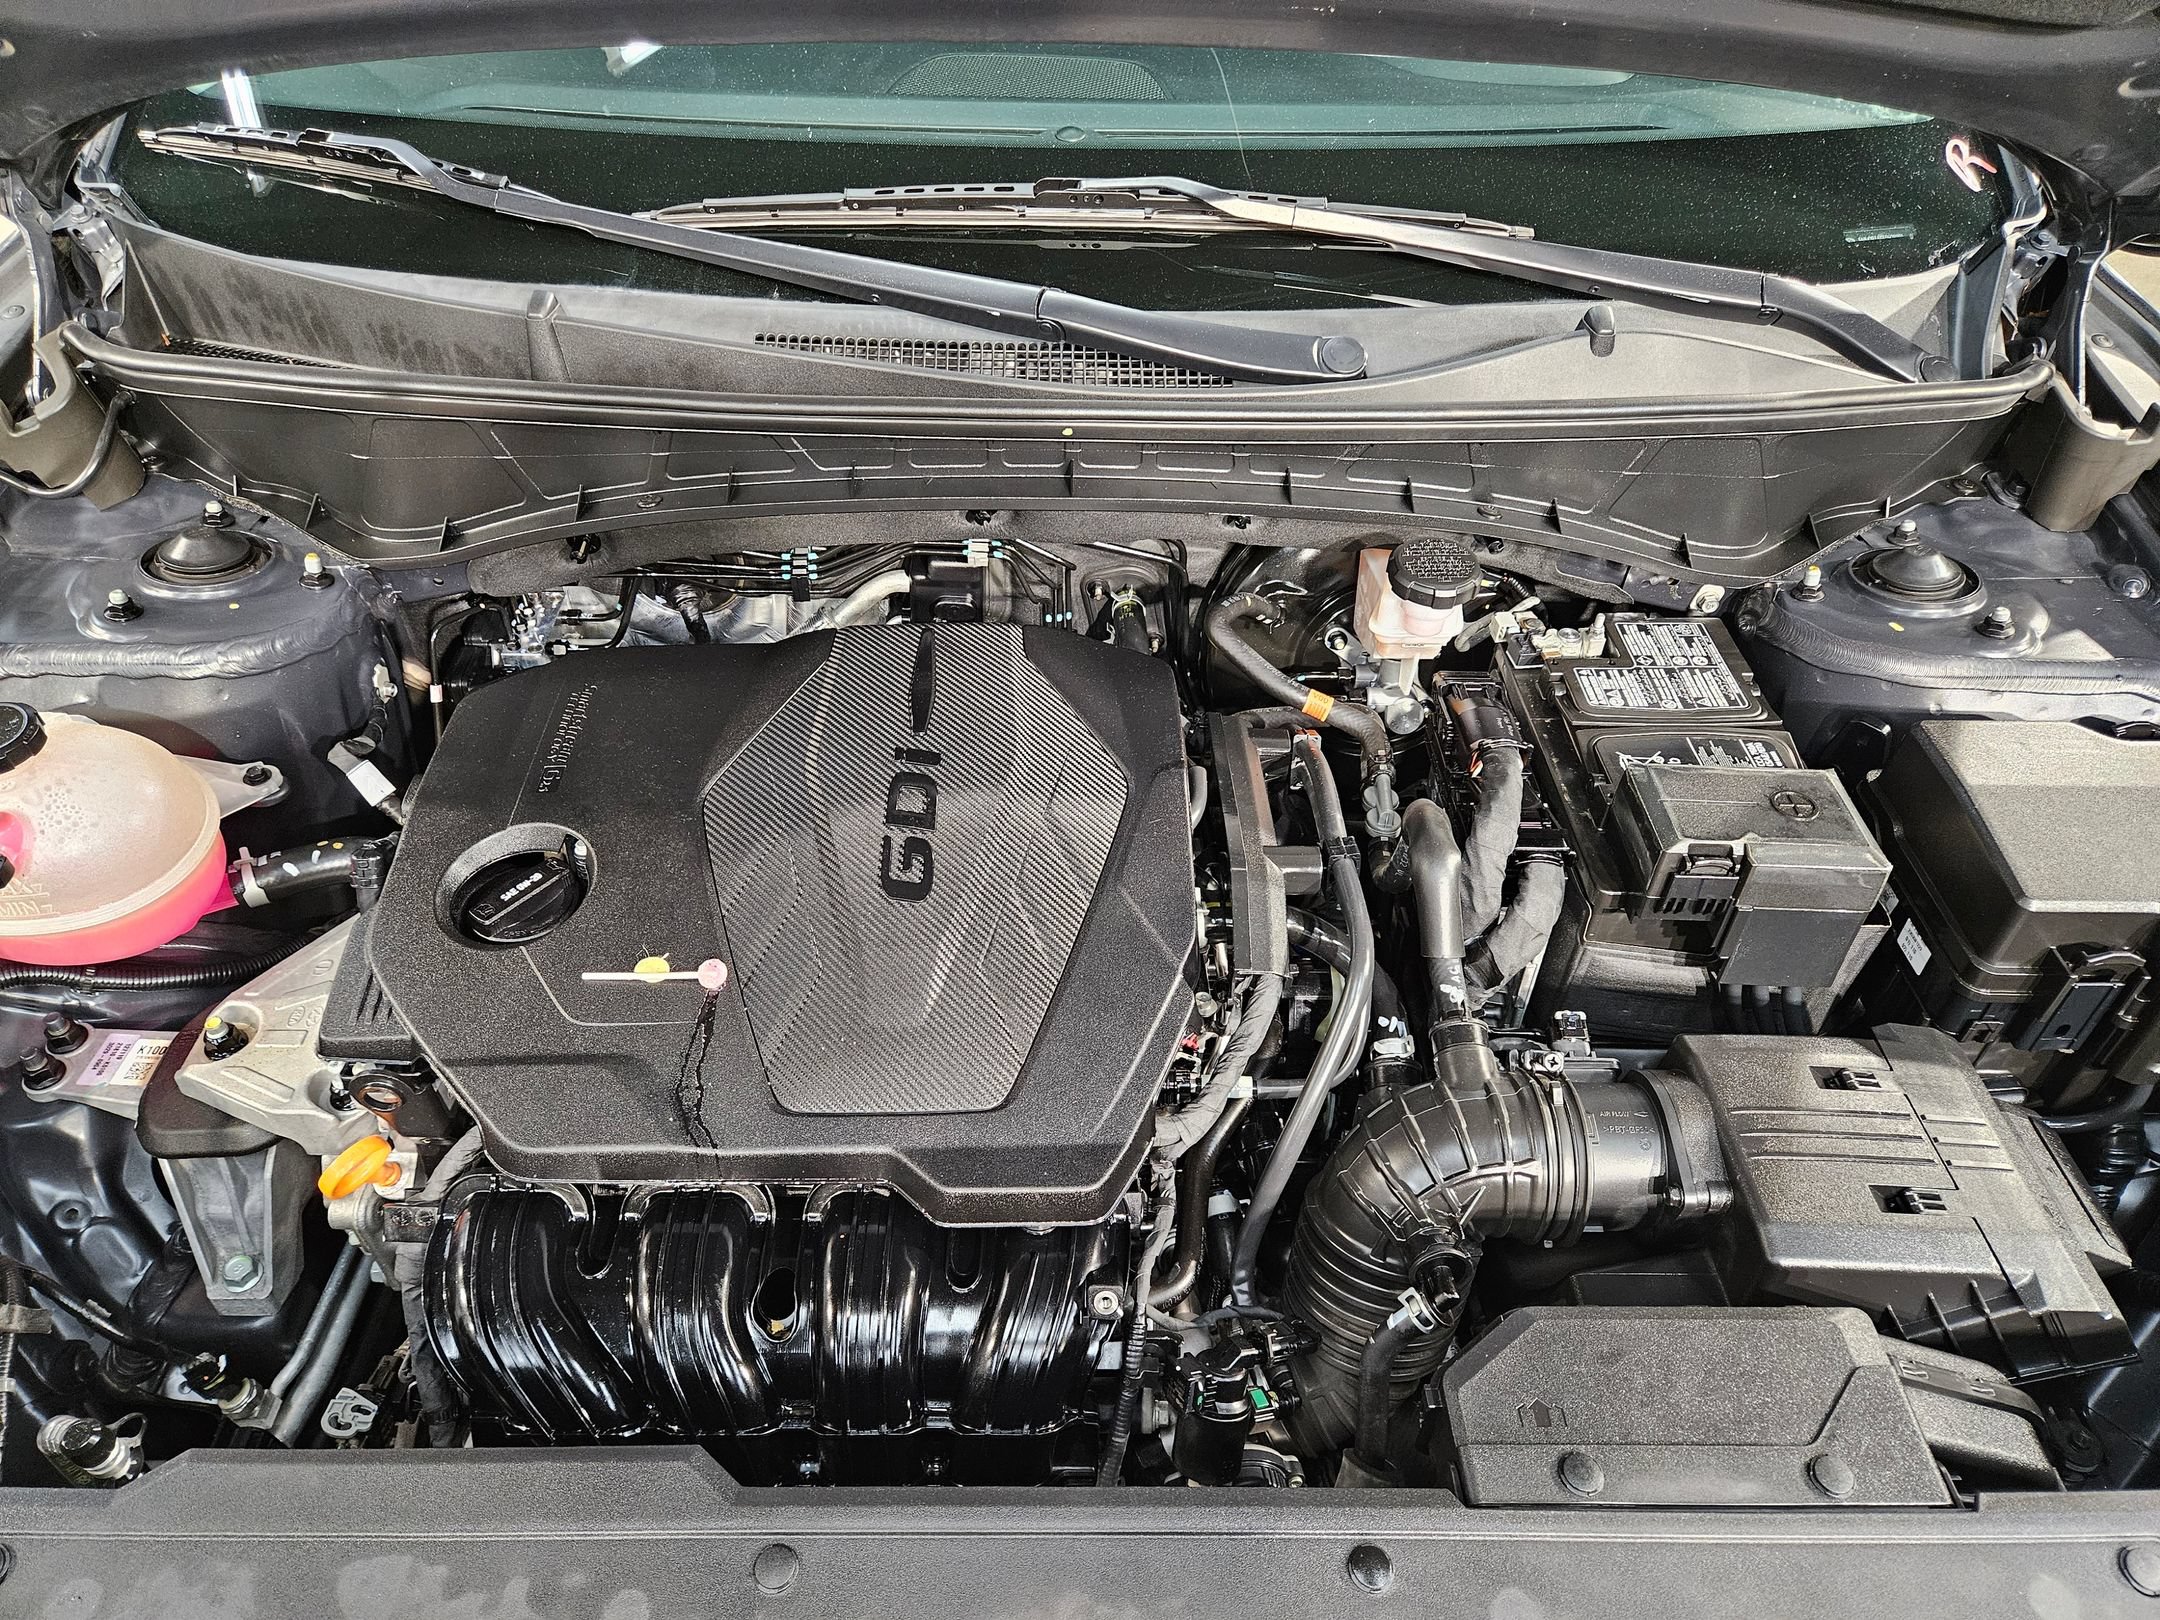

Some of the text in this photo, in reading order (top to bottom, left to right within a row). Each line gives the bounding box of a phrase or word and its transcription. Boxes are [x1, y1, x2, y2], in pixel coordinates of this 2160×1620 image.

[1946, 138, 1998, 192] R
[500, 872, 543, 902] SAE 0W-20
